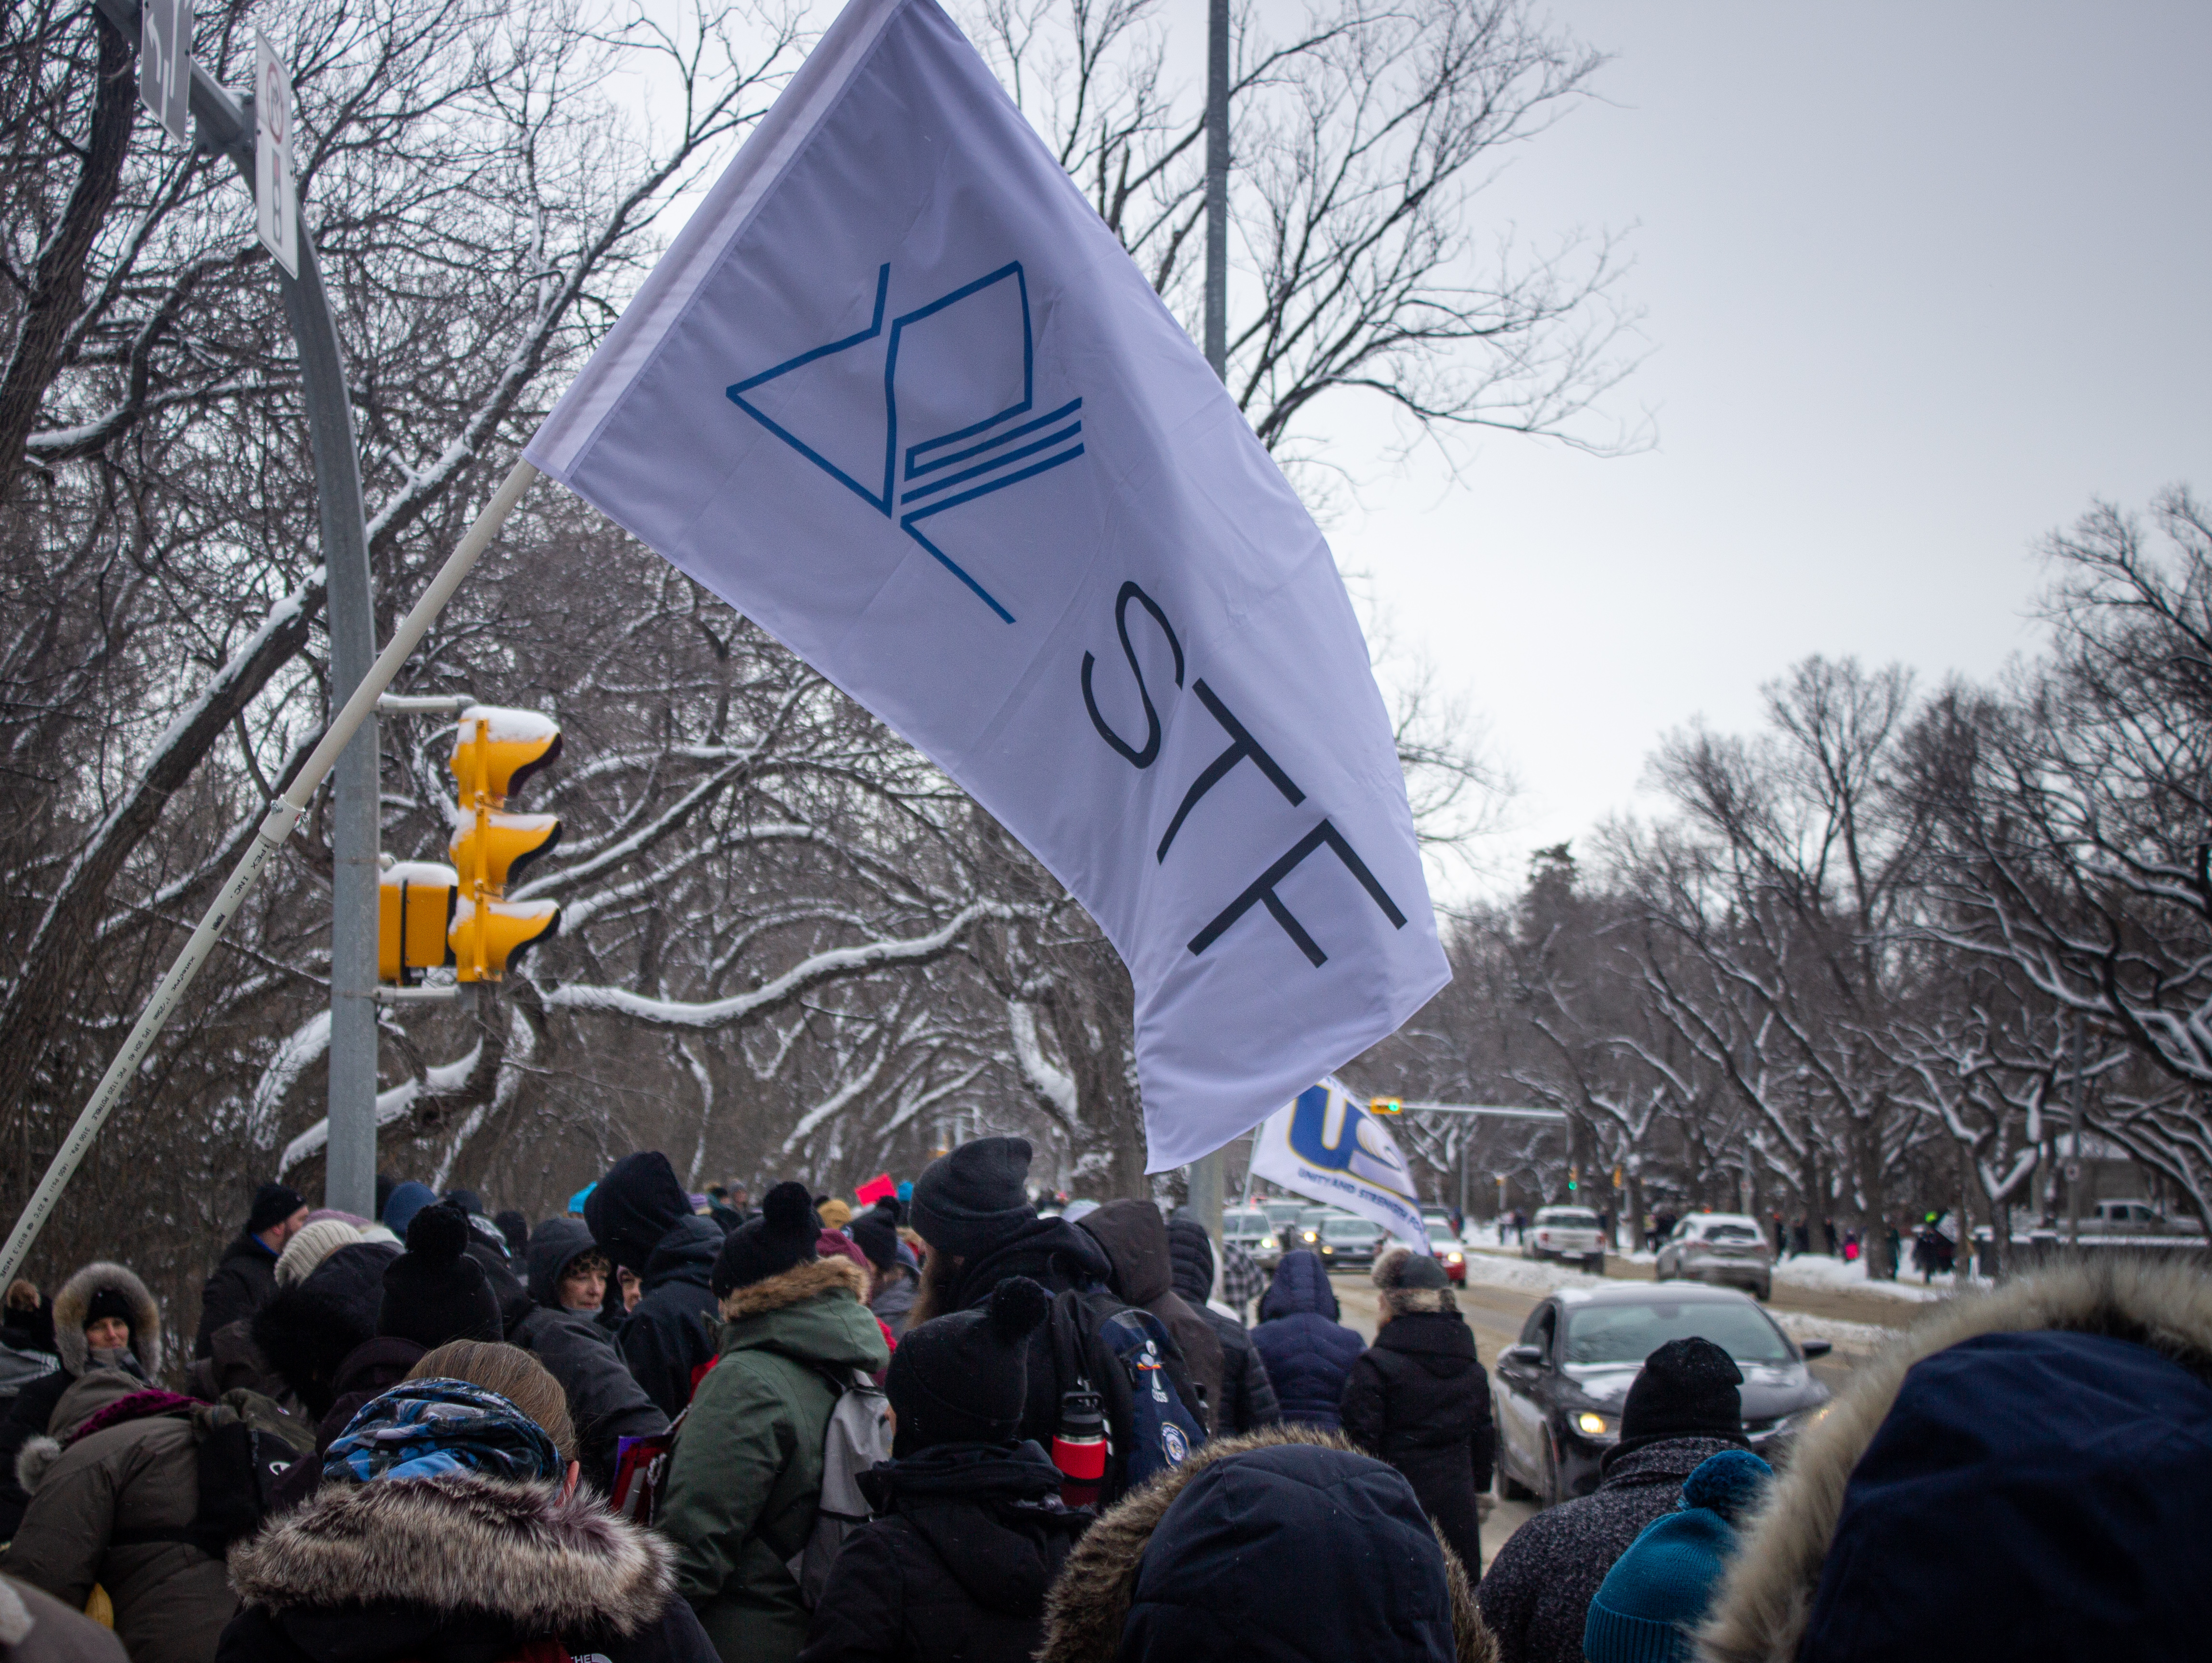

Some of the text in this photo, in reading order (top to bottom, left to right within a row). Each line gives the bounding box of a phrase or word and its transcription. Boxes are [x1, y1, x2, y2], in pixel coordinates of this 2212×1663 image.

[1081, 581, 1407, 969] STF
[250, 843, 270, 870] IPEX
[230, 875, 249, 899] INC.
[116, 1067, 127, 1079] PVC
[107, 1081, 118, 1095] 1120
[1332, 1178, 1356, 1194] AND
[570, 1654, 591, 1663] HE
